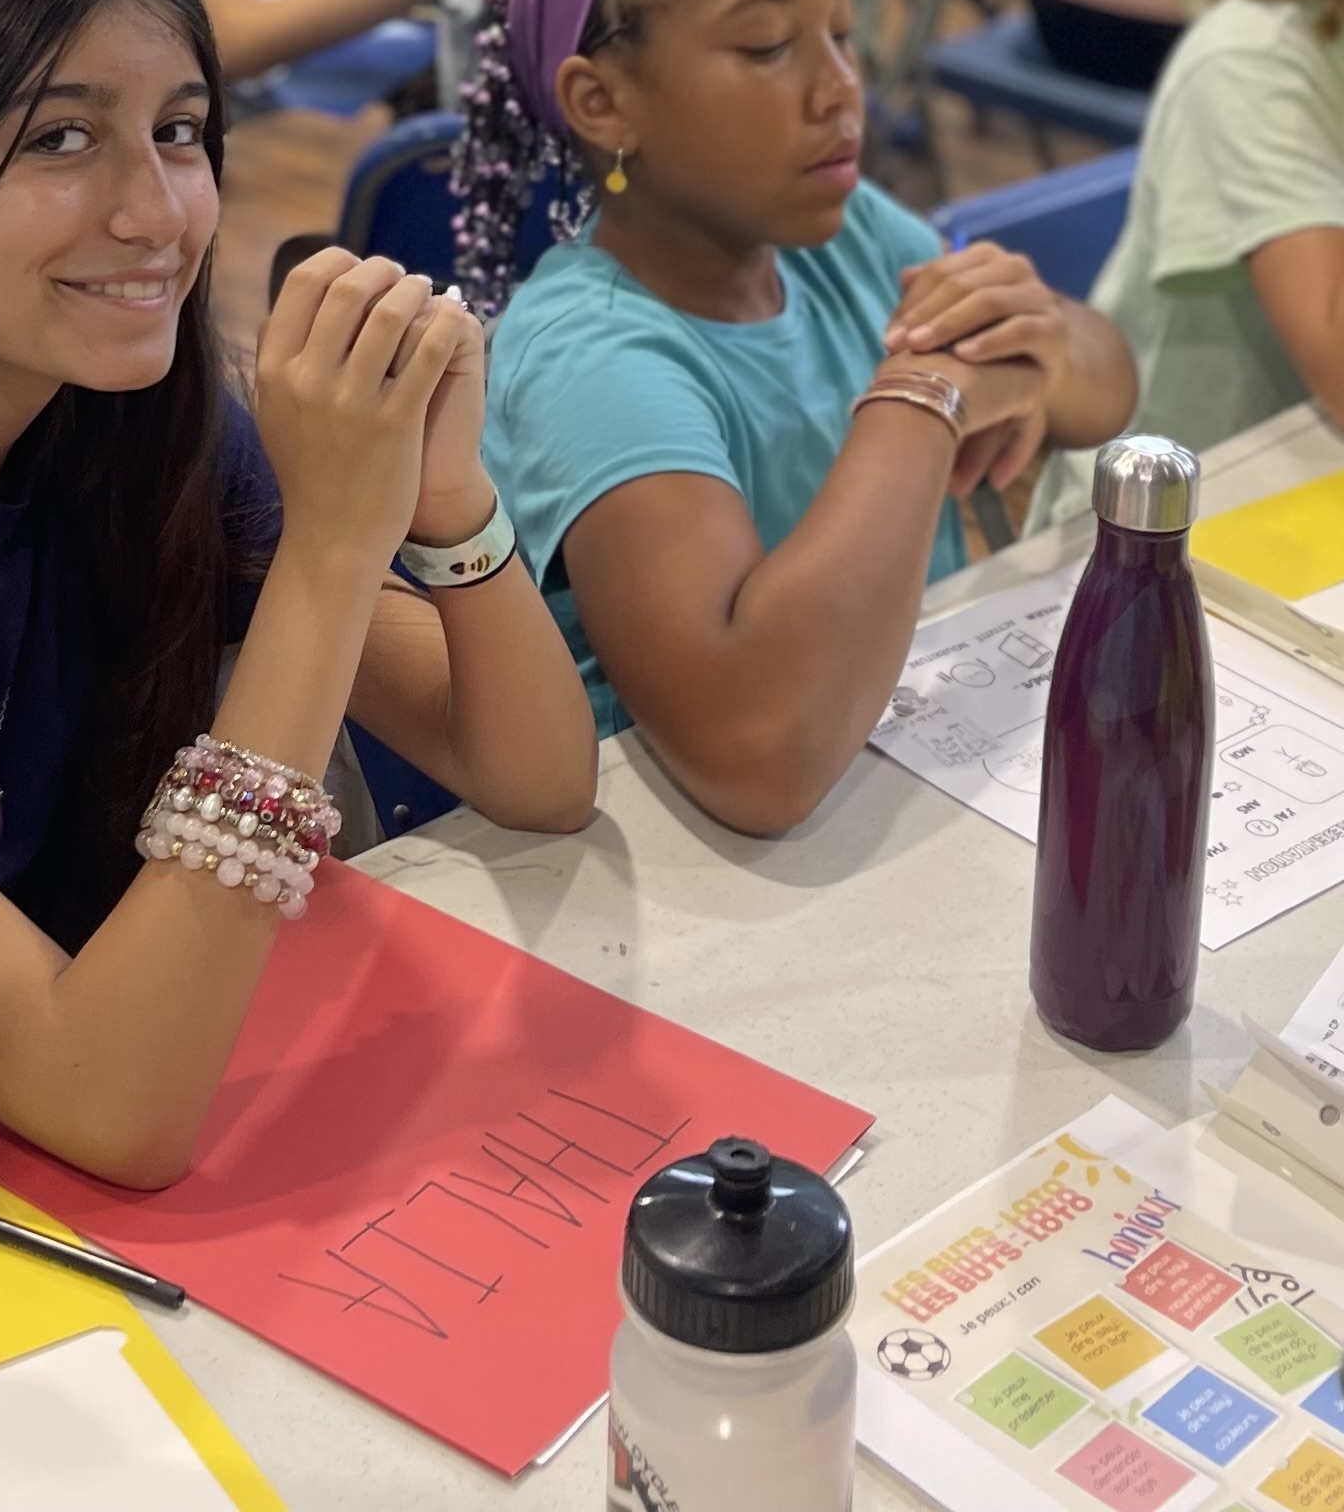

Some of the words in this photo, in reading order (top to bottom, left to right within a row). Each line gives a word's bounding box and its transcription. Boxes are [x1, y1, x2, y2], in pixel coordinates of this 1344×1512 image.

[278, 1089, 693, 1339] THALIA
[1082, 1188, 1183, 1271] bonjour
[905, 1287, 959, 1325] LES
[953, 1245, 1024, 1294] BUTS
[1028, 1195, 1094, 1243] LOTO
[1147, 1255, 1171, 1275] peux
[1144, 1277, 1166, 1296] dire
[959, 1321, 977, 1336] Je
[1016, 1276, 1042, 1297] can
[1078, 1313, 1106, 1336] peux
[1070, 1336, 1095, 1355] dire
[1001, 1376, 1029, 1399] peux
[1189, 1388, 1216, 1414] peux
[1186, 1411, 1211, 1434] dire
[1214, 1411, 1260, 1452] couleurs
